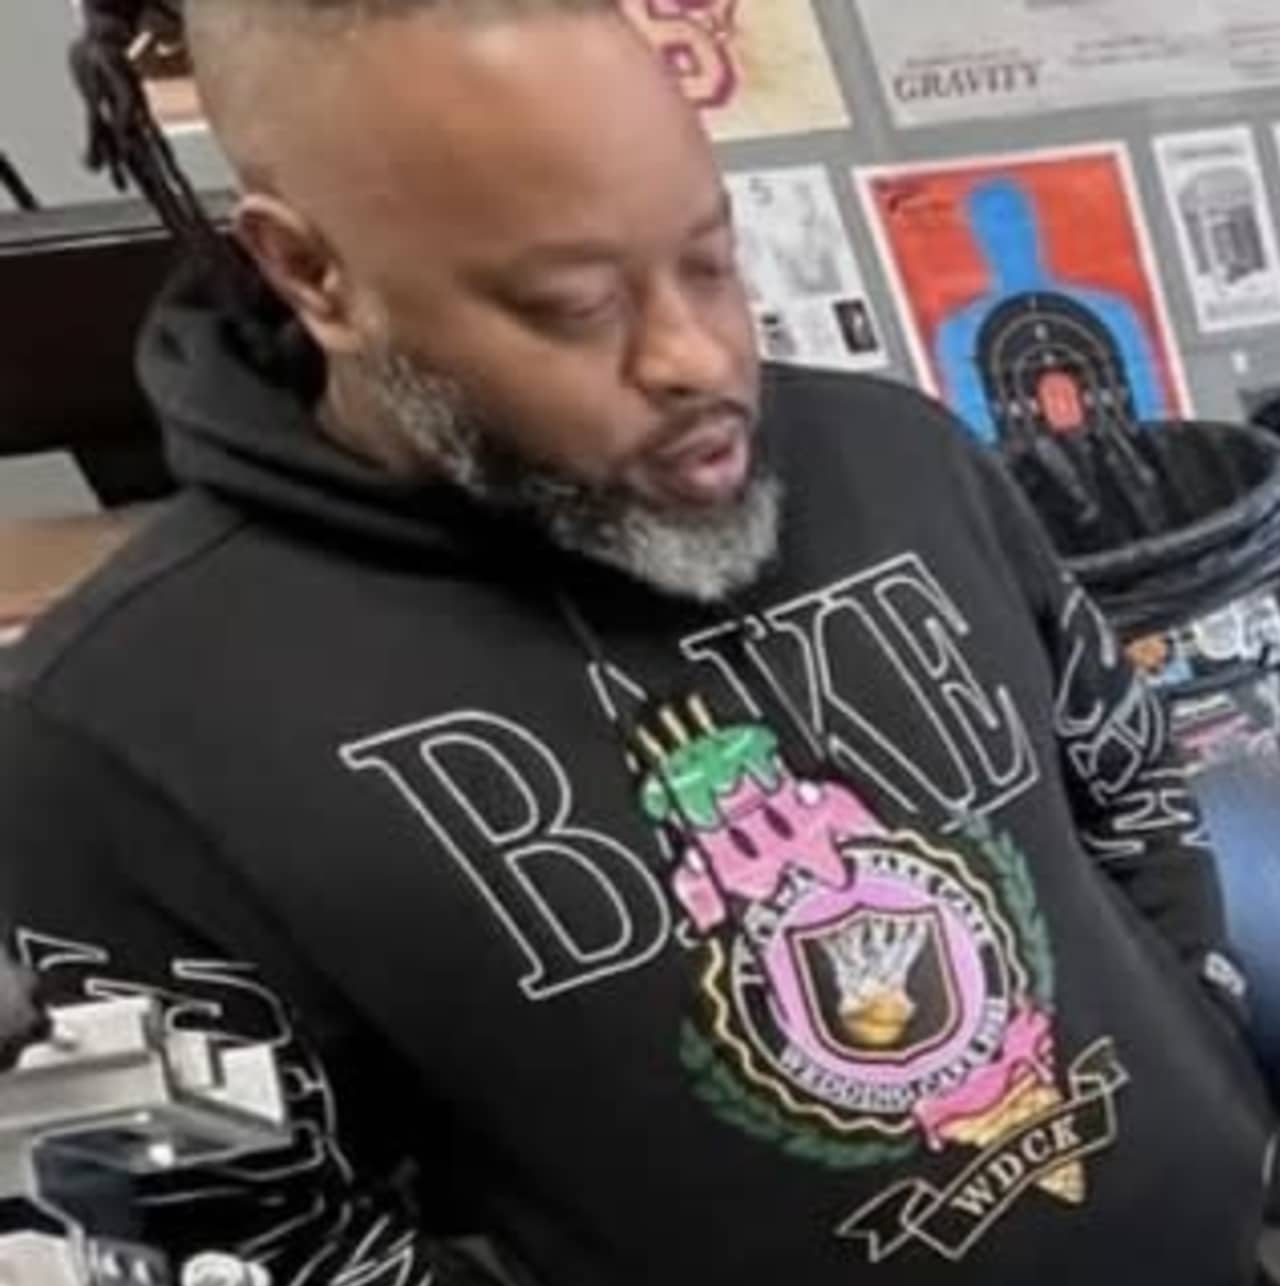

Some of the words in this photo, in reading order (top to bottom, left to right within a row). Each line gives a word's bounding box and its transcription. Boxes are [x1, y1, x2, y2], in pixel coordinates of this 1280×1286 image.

[892, 62, 1041, 102] GRAVITY
[338, 552, 1041, 1002] BKE
[950, 1113, 1081, 1219] WDCK
